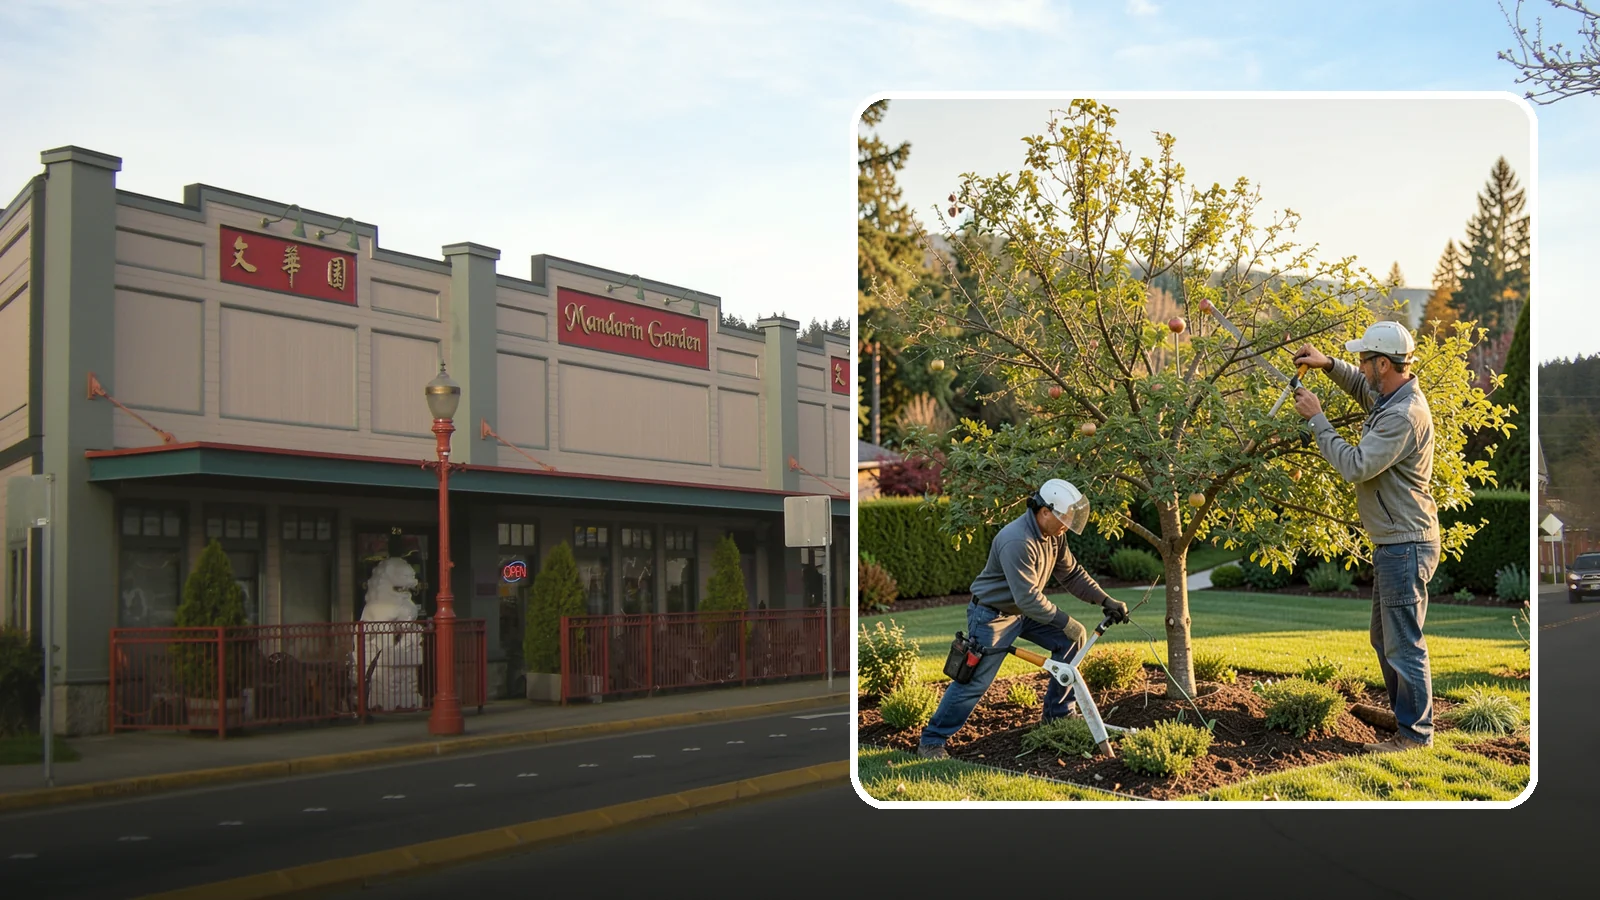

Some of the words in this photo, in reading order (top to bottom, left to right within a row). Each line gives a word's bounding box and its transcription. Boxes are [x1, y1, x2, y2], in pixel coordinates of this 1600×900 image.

[231, 236, 346, 291] 文華園
[564, 302, 644, 340] Mandarin
[648, 320, 701, 352] Garden
[503, 565, 527, 578] OPEN
